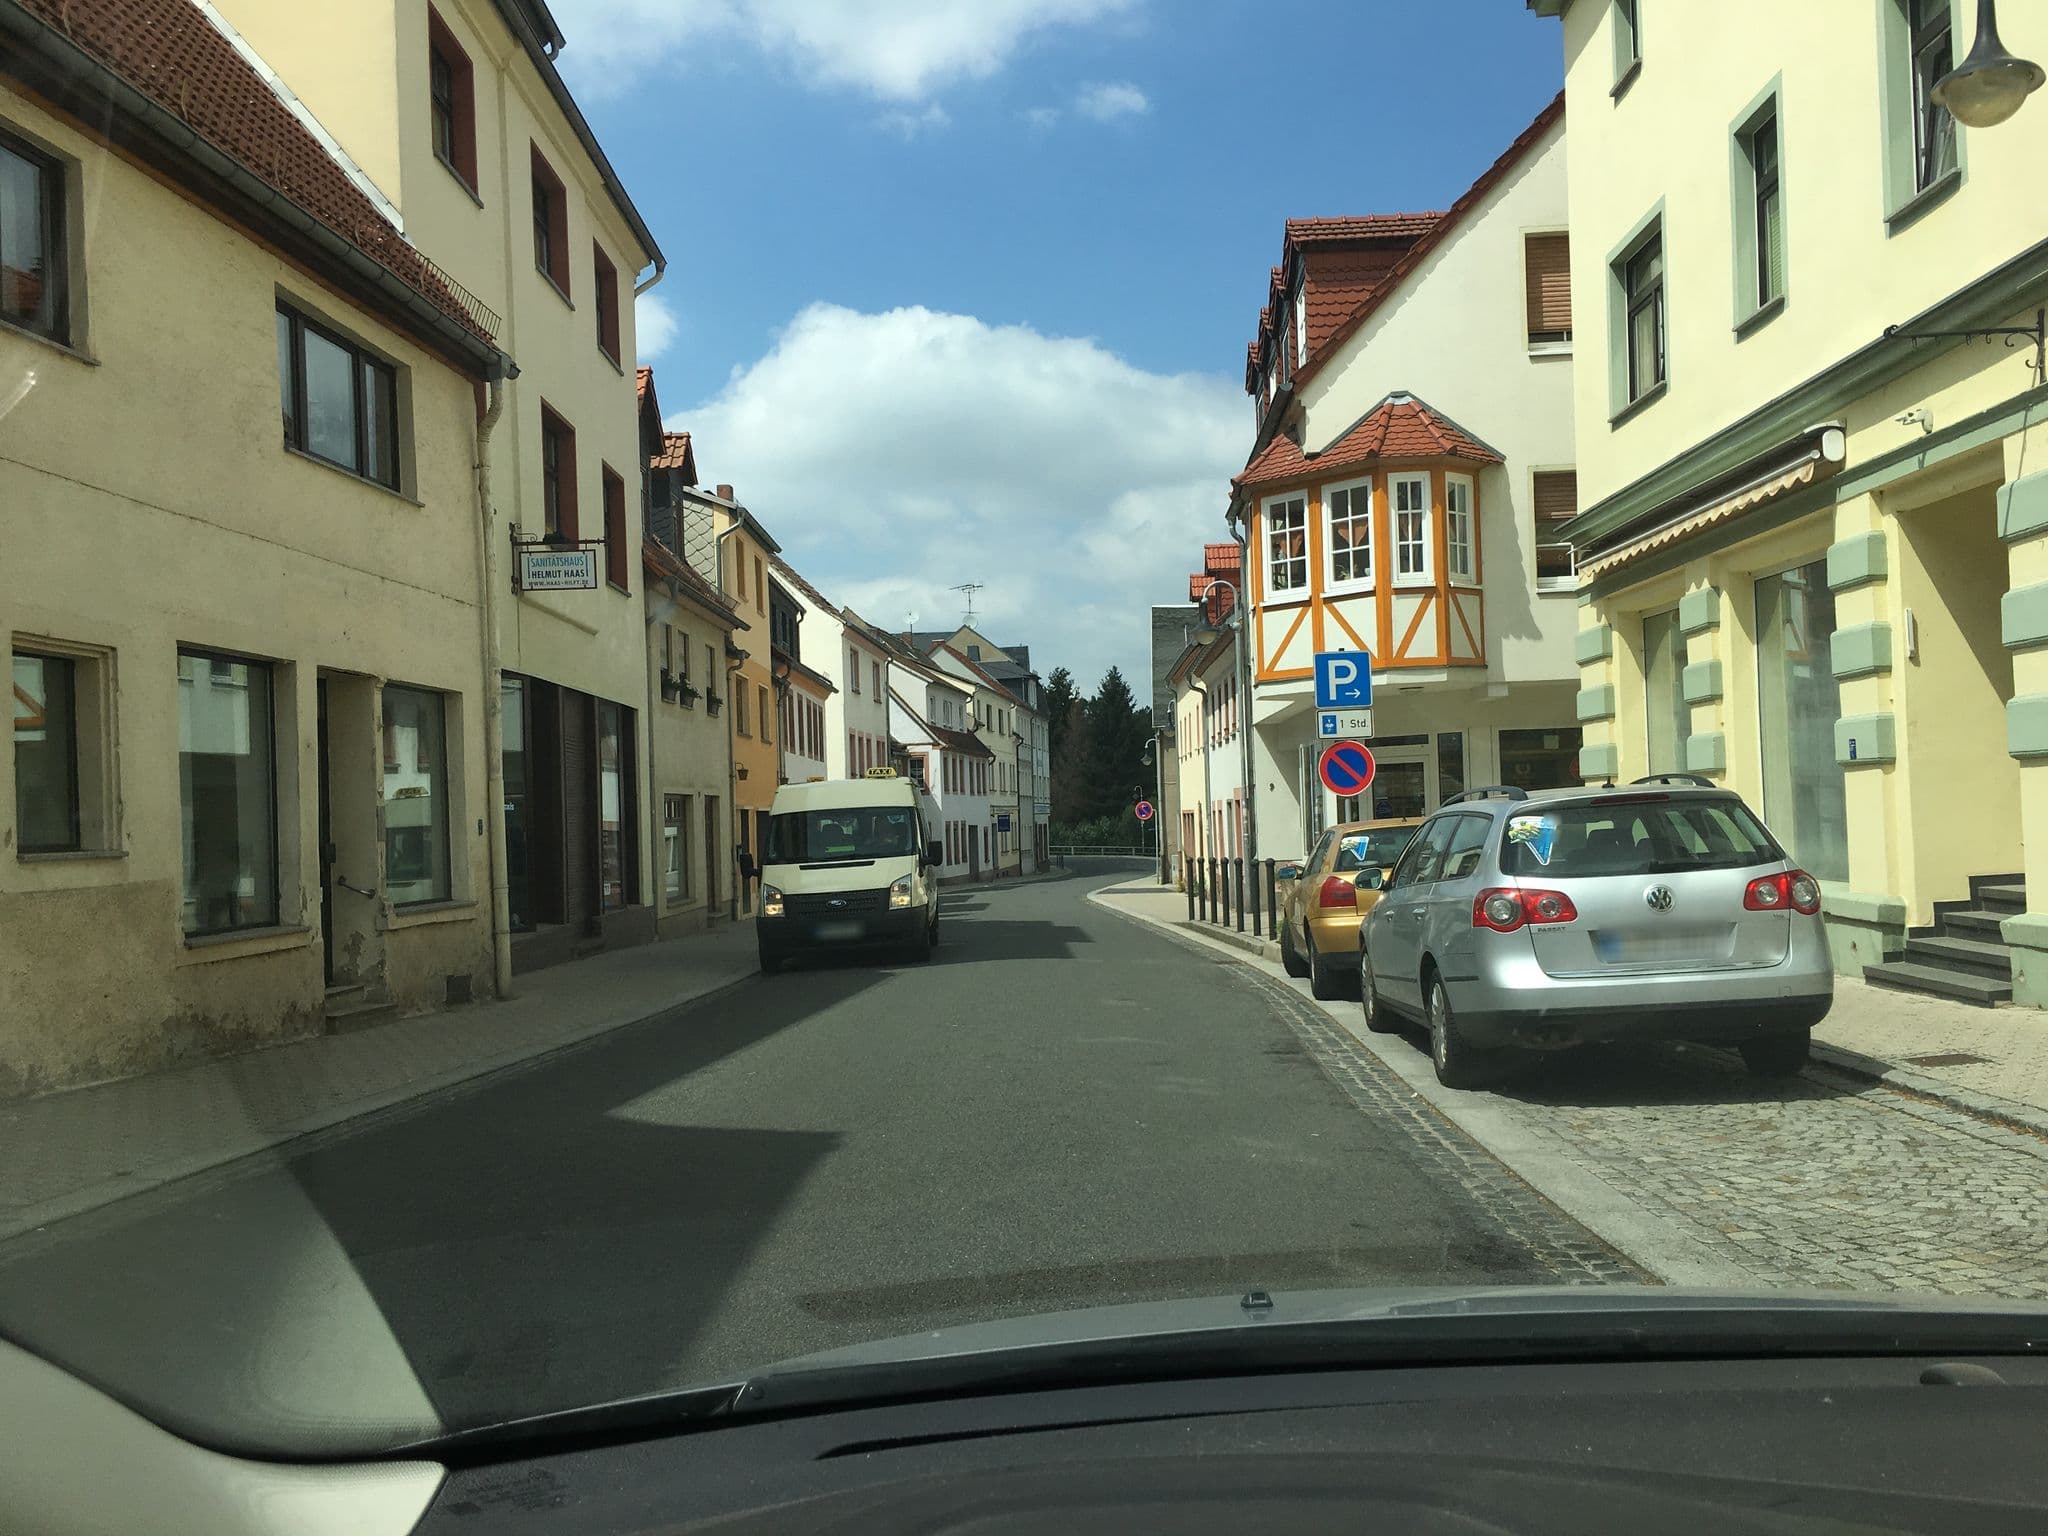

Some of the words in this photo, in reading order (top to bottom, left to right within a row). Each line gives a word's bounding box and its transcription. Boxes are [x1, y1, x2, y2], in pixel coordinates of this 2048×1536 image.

[531, 570, 561, 579] HELMUT
[564, 569, 585, 578] HAAS
[1328, 660, 1357, 700] P
[1340, 719, 1344, 729] 1
[1350, 719, 1369, 728] Std.
[868, 768, 892, 776] TAXI
